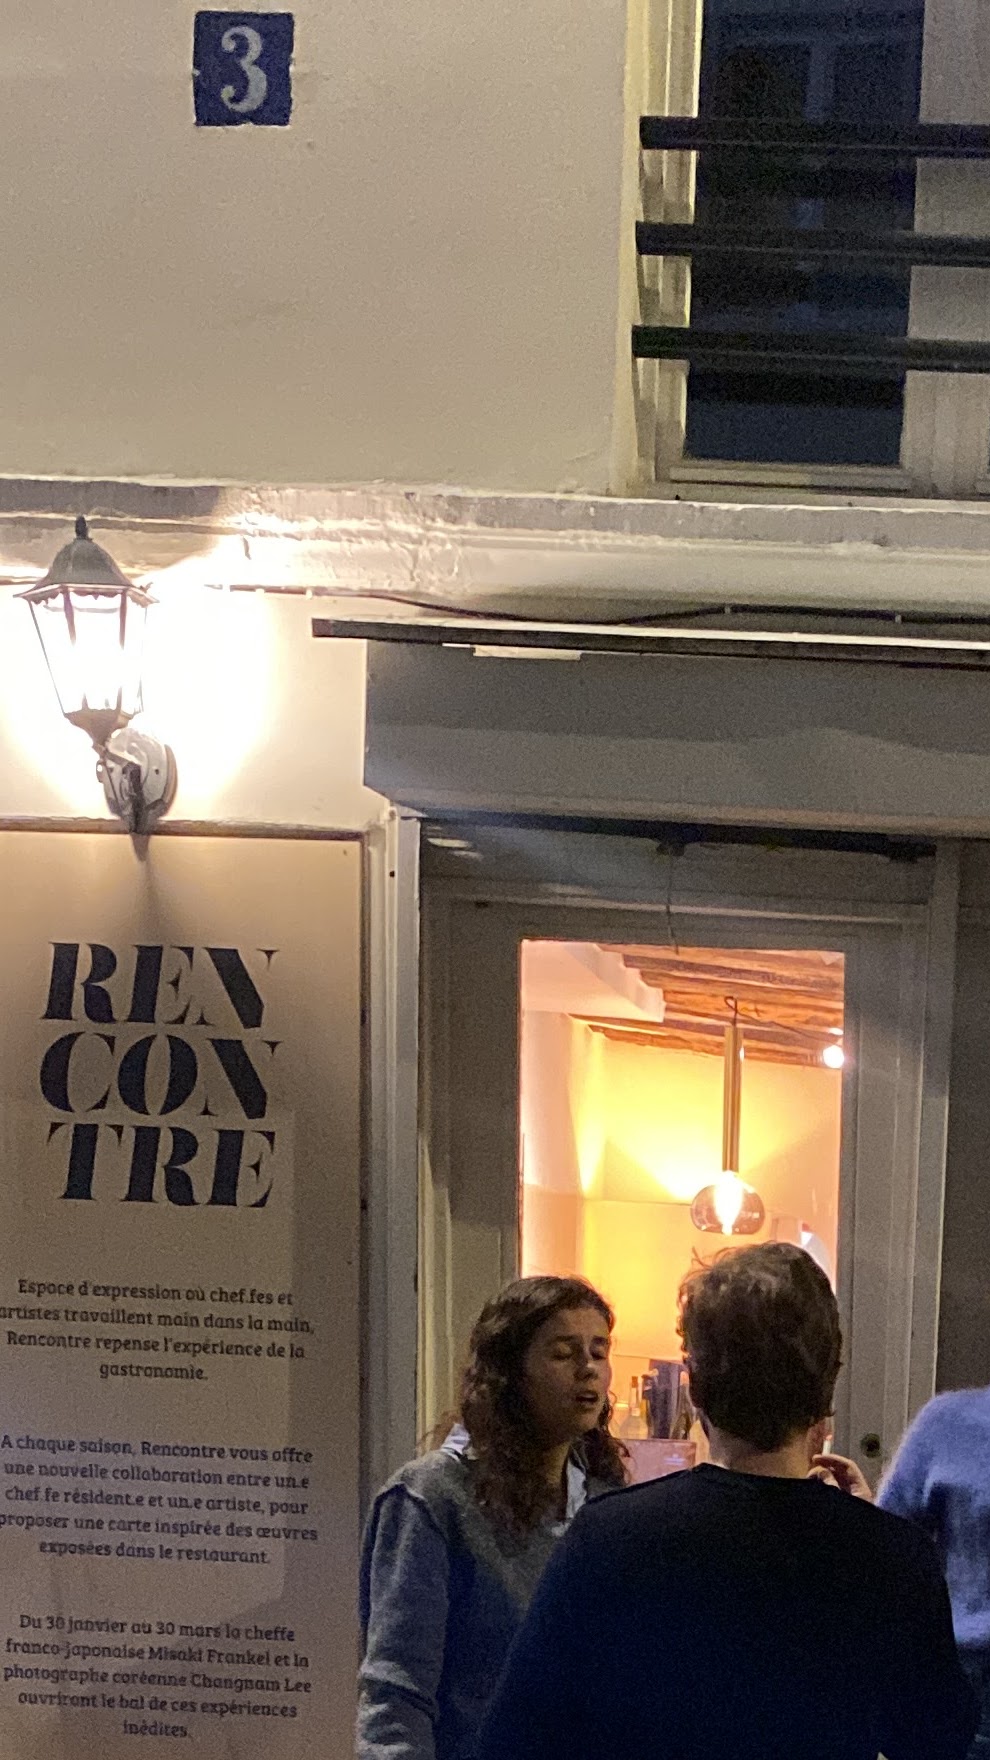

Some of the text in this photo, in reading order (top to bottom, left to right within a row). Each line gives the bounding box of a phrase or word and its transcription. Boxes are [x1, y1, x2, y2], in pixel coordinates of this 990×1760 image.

[220, 25, 268, 113] 3
[40, 941, 280, 1029] REN
[39, 1031, 283, 1120] CON
[47, 1121, 276, 1208] TRE
[18, 1279, 75, 1297] Espace
[78, 1281, 182, 1301] d'expression
[185, 1286, 206, 1301] où
[277, 1293, 293, 1305] et
[0, 1305, 315, 1335] artistes travaillent main dans la main,
[6, 1331, 306, 1359] Rencontre repense l'expérience de la
[16, 1435, 76, 1455] chaque
[140, 1441, 226, 1459] Rencontre
[230, 1446, 269, 1461] vous
[272, 1447, 314, 1463] offre
[4, 1463, 35, 1475] une
[38, 1463, 109, 1479] nouvelle
[112, 1464, 223, 1485] collaboration
[227, 1473, 271, 1487] entre
[148, 1494, 164, 1507] et
[269, 1500, 309, 1516] pour
[0, 1514, 318, 1541] proposer une carte inspirée des œuvres
[39, 1541, 112, 1556] exposées
[115, 1541, 156, 1559] dans
[159, 1544, 173, 1559] le
[20, 1614, 295, 1642] Du 30 janvier au 30 mars la cheffe
[6, 1638, 310, 1668] franco-japonaise Misaki Frankel et la
[3, 1664, 312, 1694] photographe coréenne Changnam Lee
[18, 1691, 298, 1718] ouvriront le bal de ces expériences
